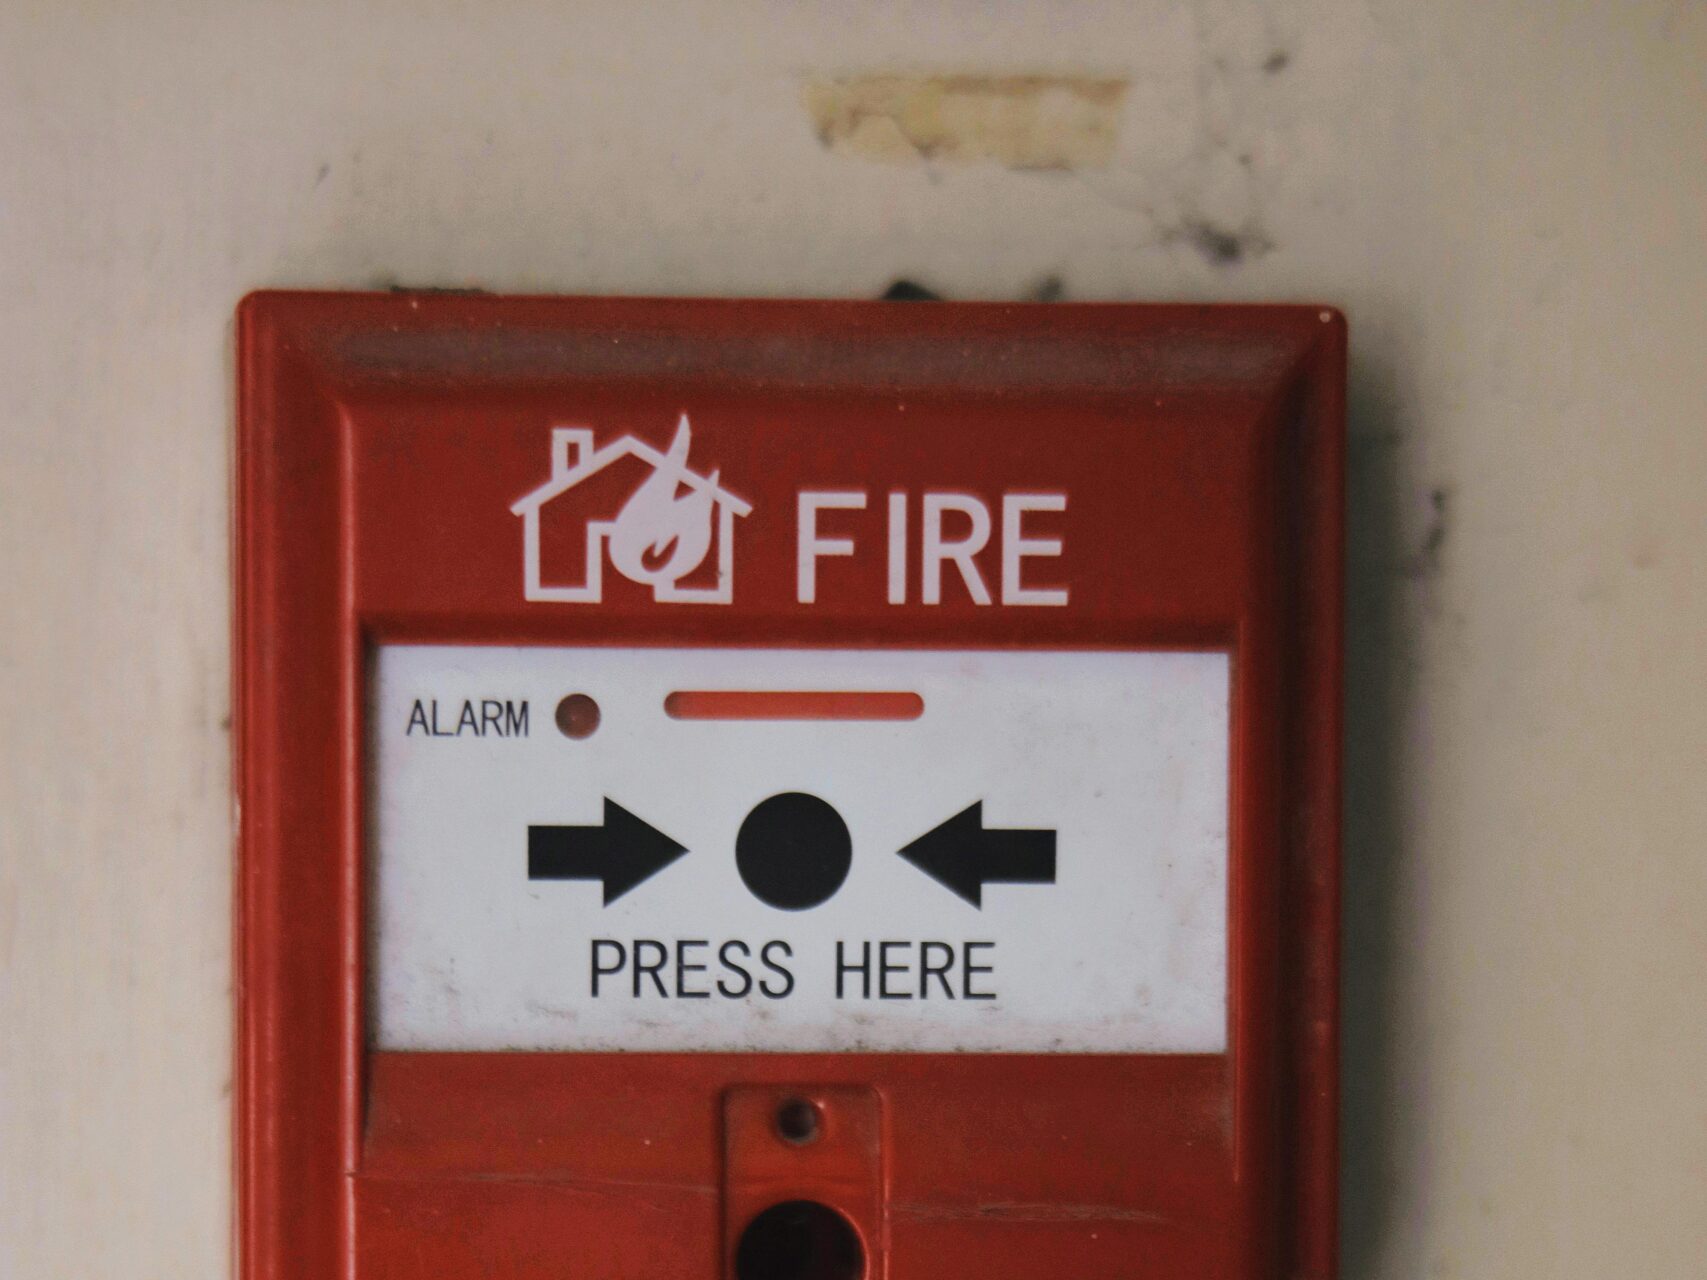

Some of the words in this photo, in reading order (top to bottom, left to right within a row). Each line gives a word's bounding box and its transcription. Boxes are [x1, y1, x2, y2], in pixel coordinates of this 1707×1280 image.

[795, 490, 1070, 608] FIRE
[405, 697, 530, 738] ALARM
[589, 938, 796, 1000] PRESS
[834, 939, 998, 1001] HERE
